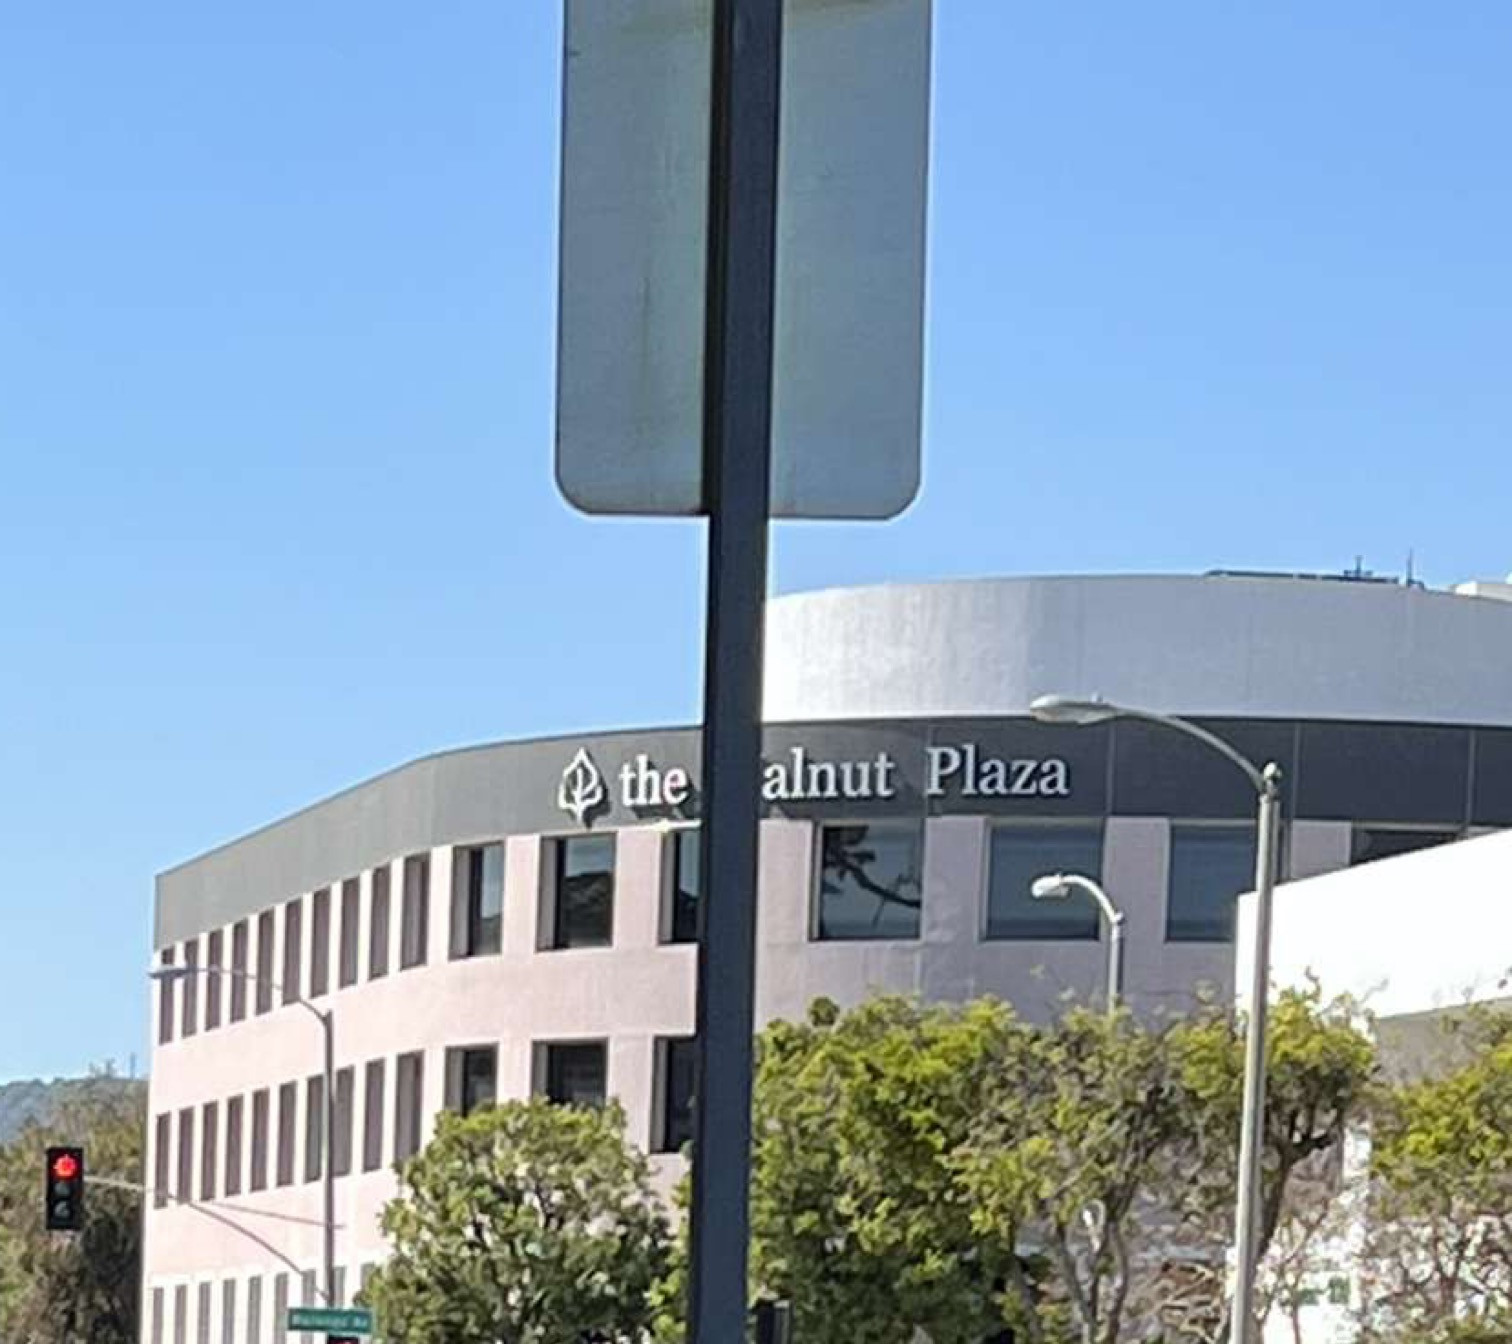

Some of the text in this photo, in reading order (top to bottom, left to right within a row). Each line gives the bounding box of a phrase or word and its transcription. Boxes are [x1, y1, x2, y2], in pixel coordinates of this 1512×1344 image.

[619, 744, 1070, 806] the alnut Plaza
